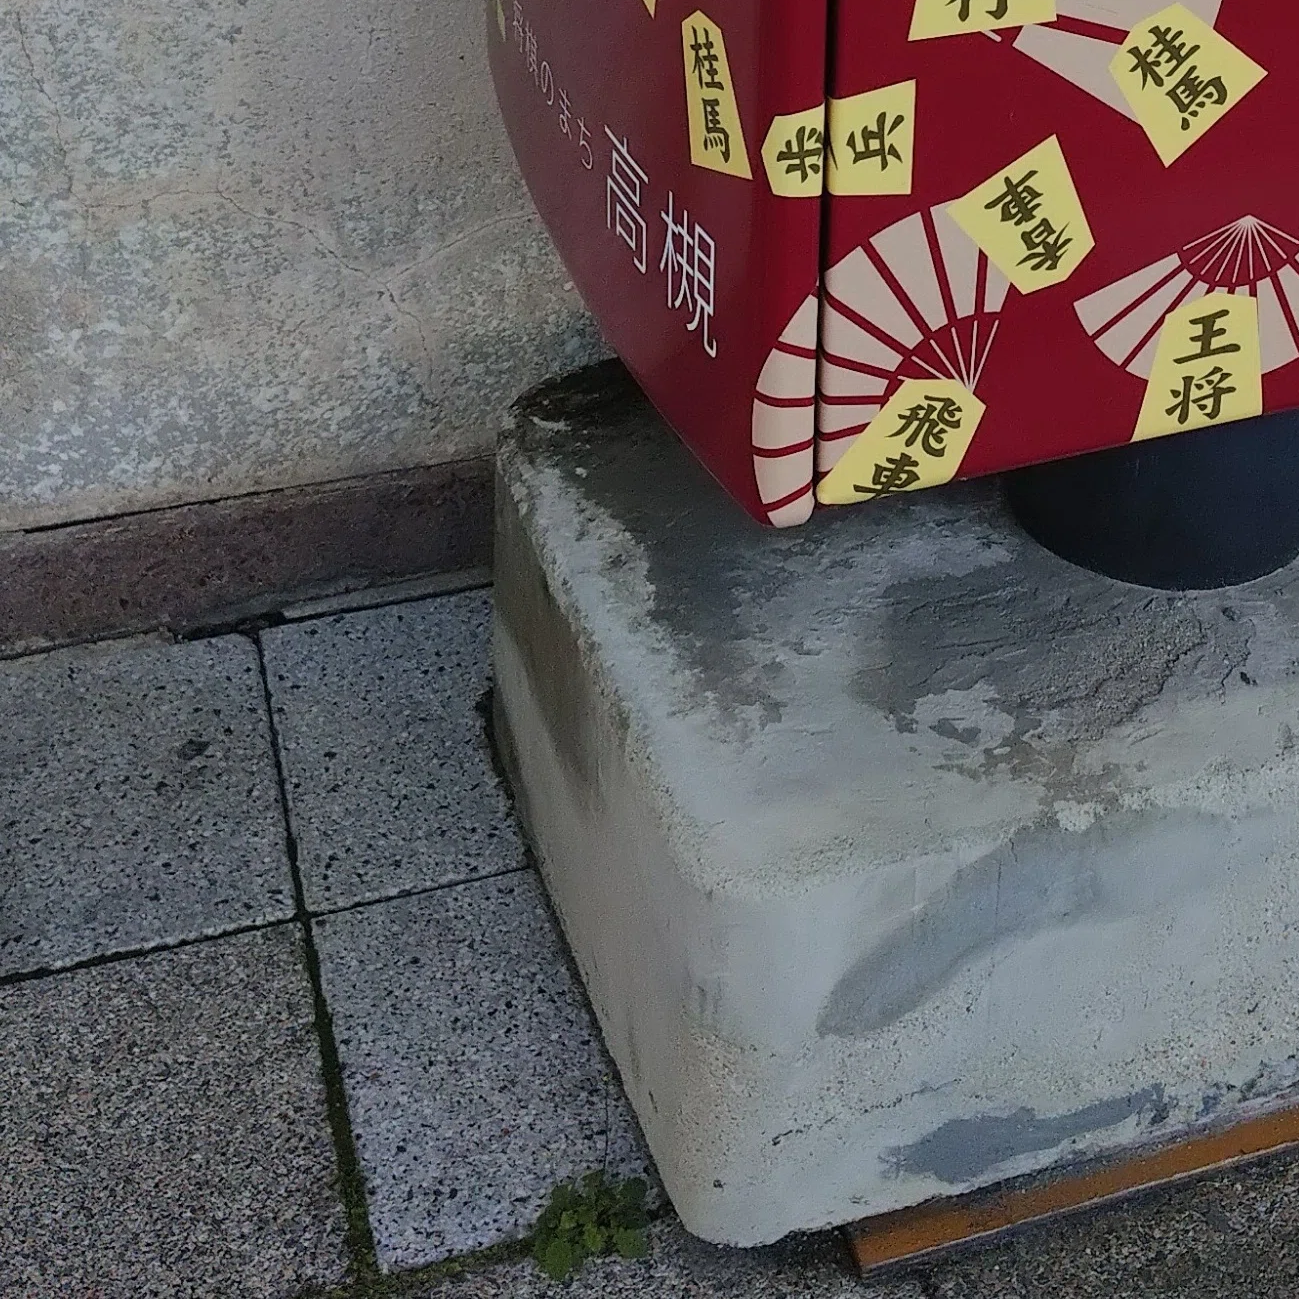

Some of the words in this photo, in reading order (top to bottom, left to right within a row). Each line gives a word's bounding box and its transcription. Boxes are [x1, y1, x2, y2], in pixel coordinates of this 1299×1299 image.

[689, 25, 731, 164] 桂馬
[1127, 25, 1229, 131] 桂馬
[776, 110, 905, 183] 歩兵
[604, 125, 717, 358] 高槻
[984, 169, 1074, 272] 香車
[1165, 309, 1242, 425] 王将
[853, 395, 963, 498] 飛車
